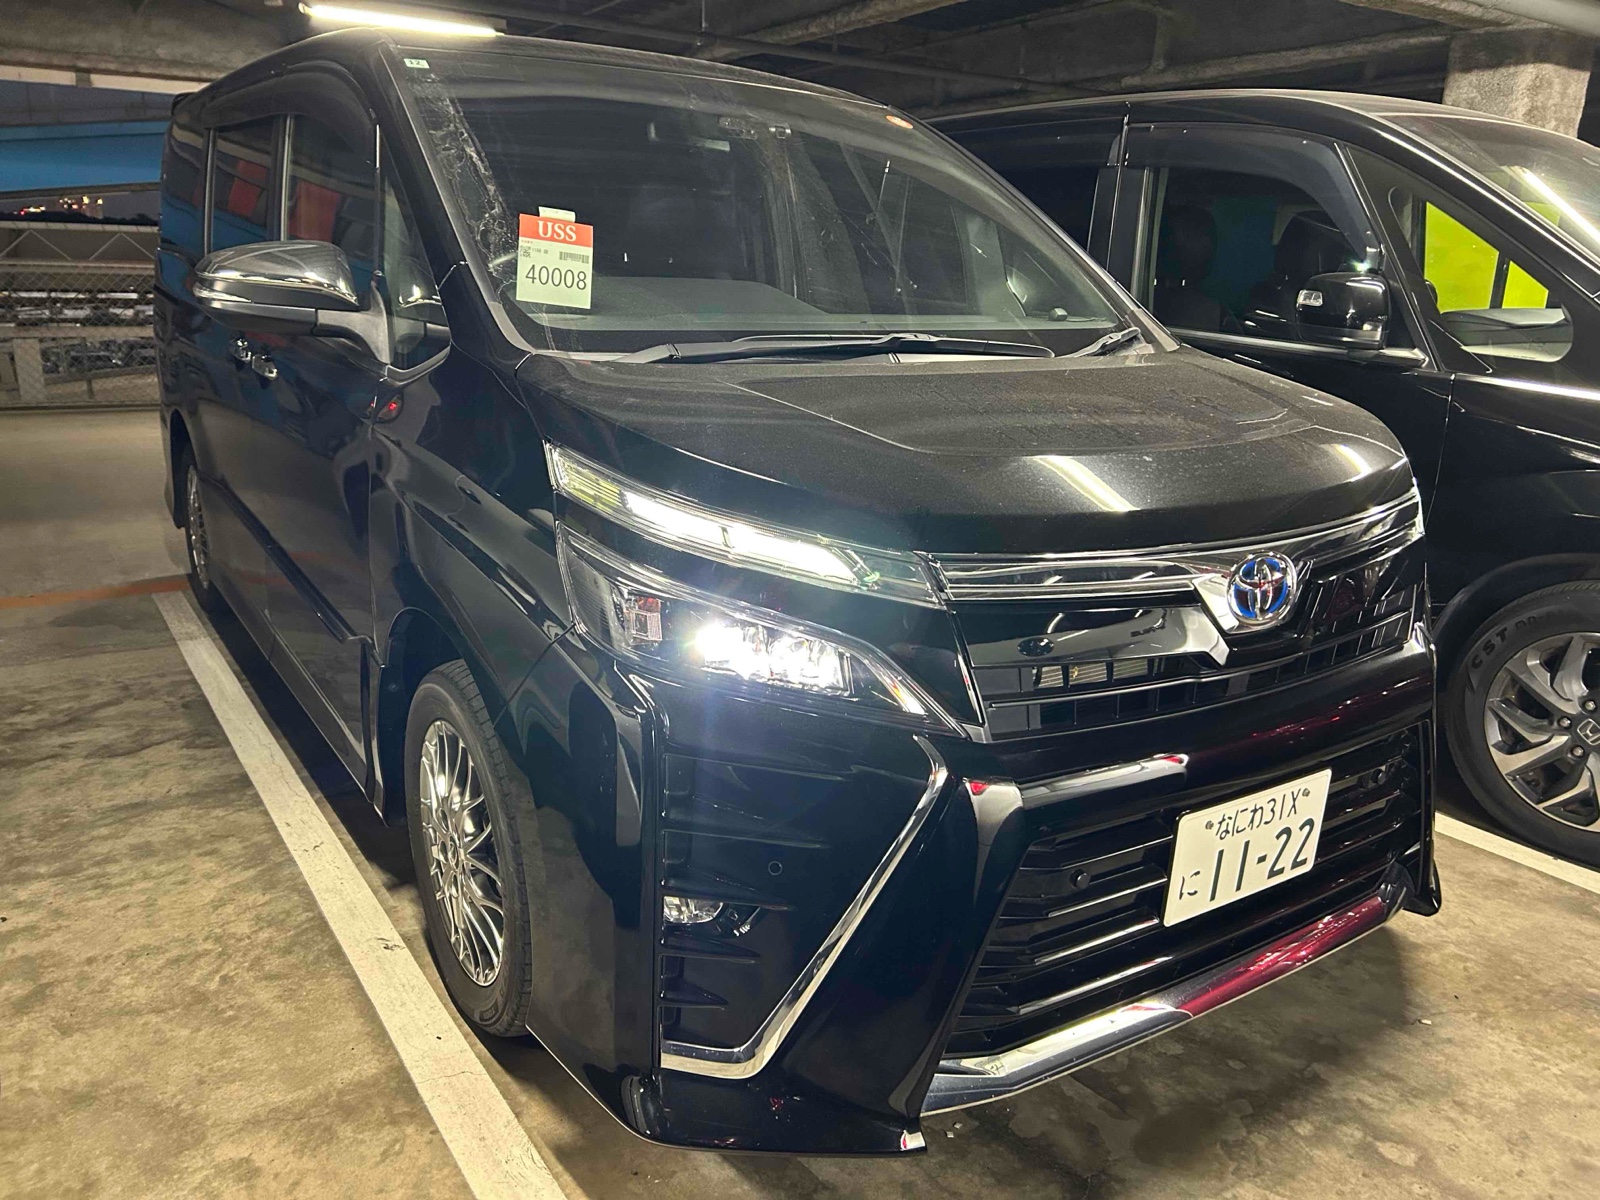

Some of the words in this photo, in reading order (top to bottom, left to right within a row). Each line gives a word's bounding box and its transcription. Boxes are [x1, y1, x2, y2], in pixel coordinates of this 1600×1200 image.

[537, 220, 577, 242] USS
[525, 264, 587, 291] 40008
[1471, 627, 1508, 670] CST
[1209, 817, 1315, 902] 11-22
[1179, 870, 1201, 900] に
